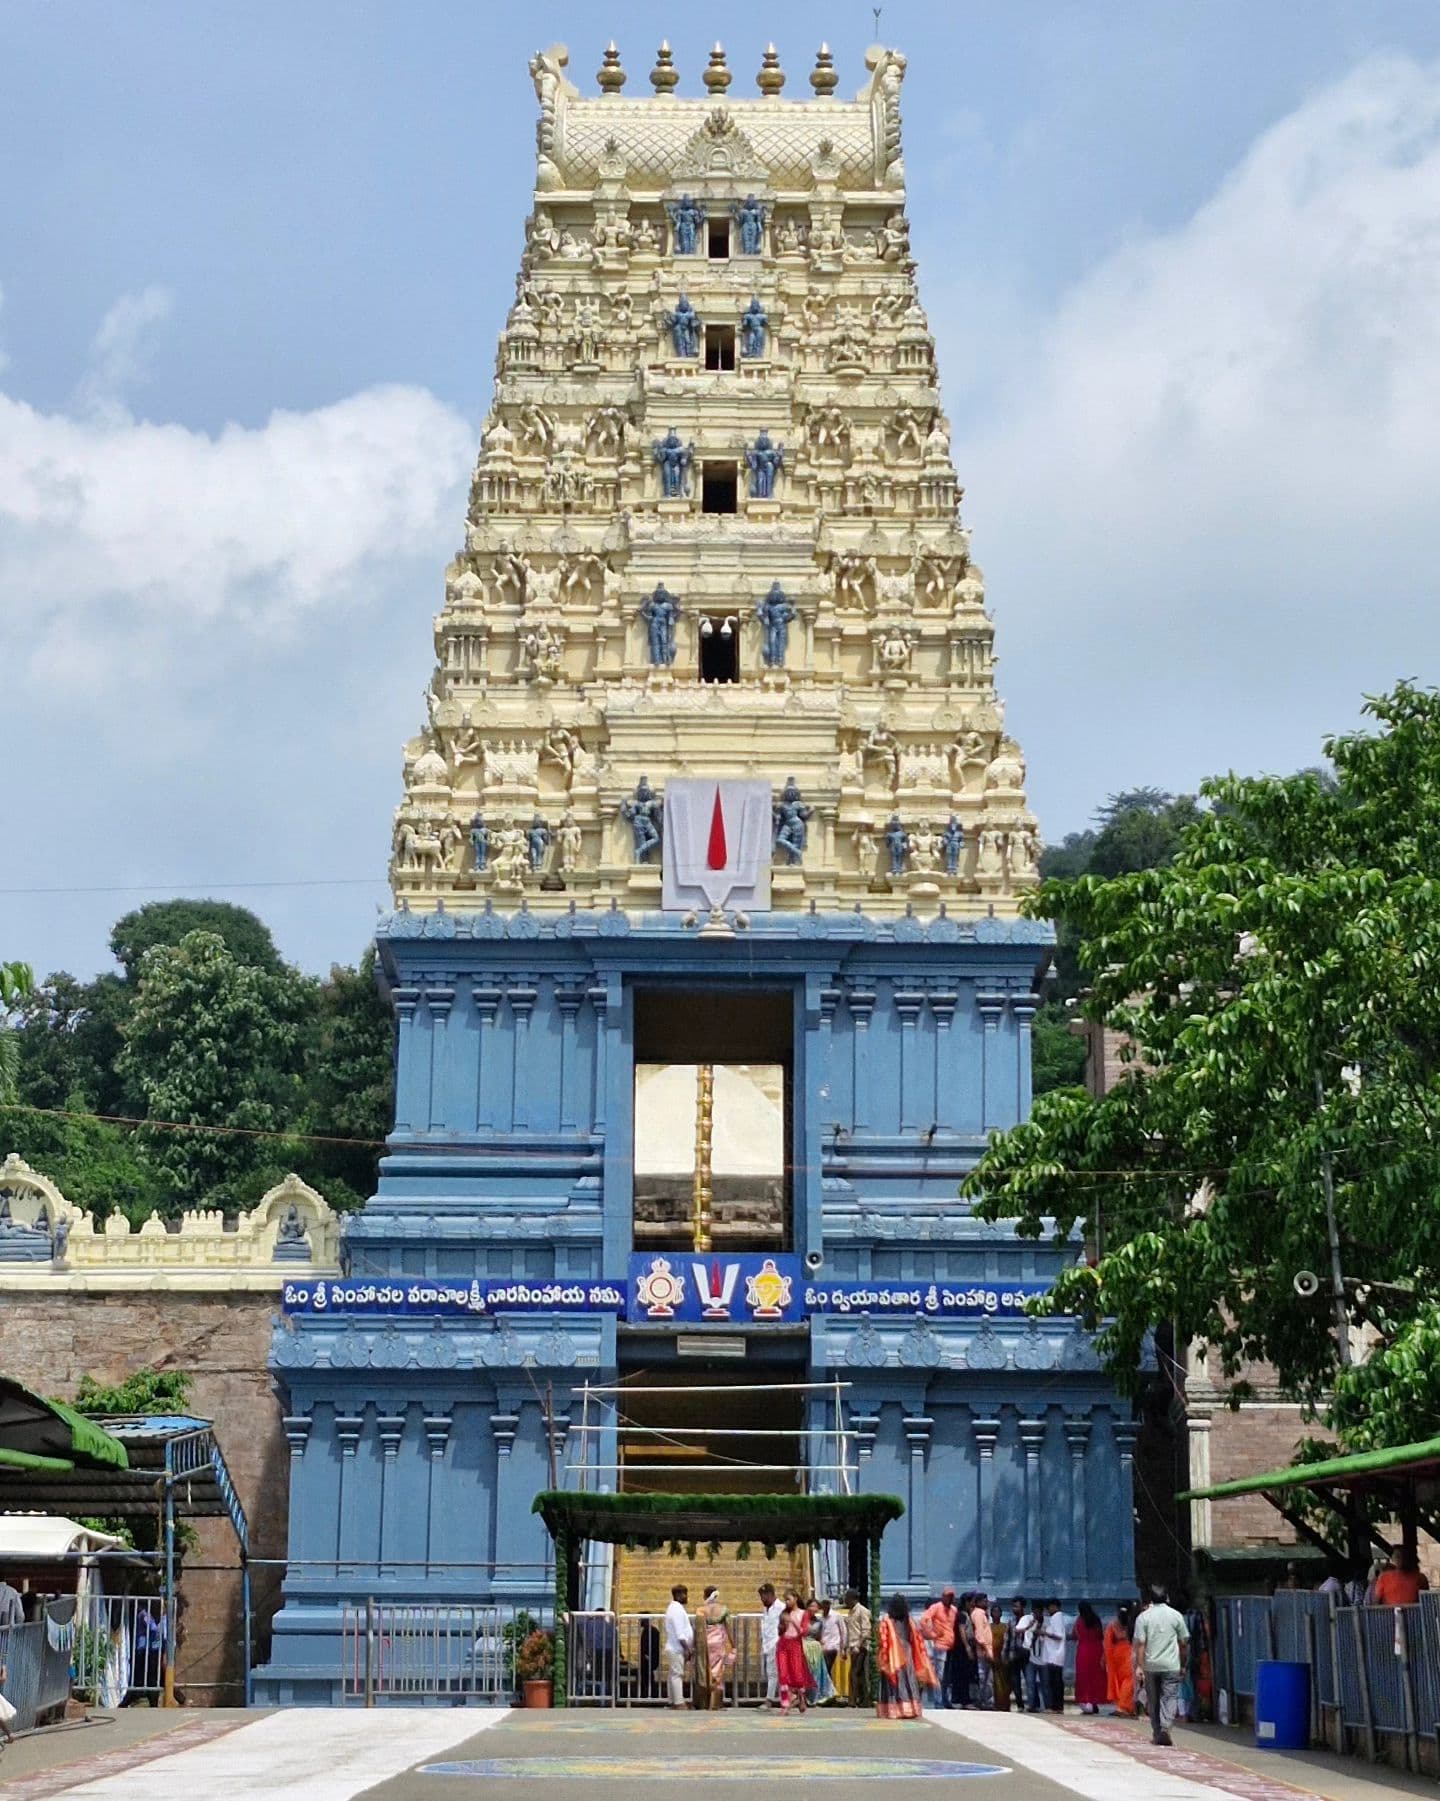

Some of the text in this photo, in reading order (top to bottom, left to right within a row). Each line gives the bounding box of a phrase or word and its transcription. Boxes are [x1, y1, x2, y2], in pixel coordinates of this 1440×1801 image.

[285, 1285, 309, 1304] ఓం
[312, 1281, 328, 1308] శ్రీ
[332, 1285, 404, 1303] సింహాచల
[805, 1287, 828, 1305] ఓం
[831, 1289, 920, 1311] ద్వయావతార
[924, 1285, 939, 1310] శ్రీ
[942, 1289, 998, 1311] సింహాద్రి
